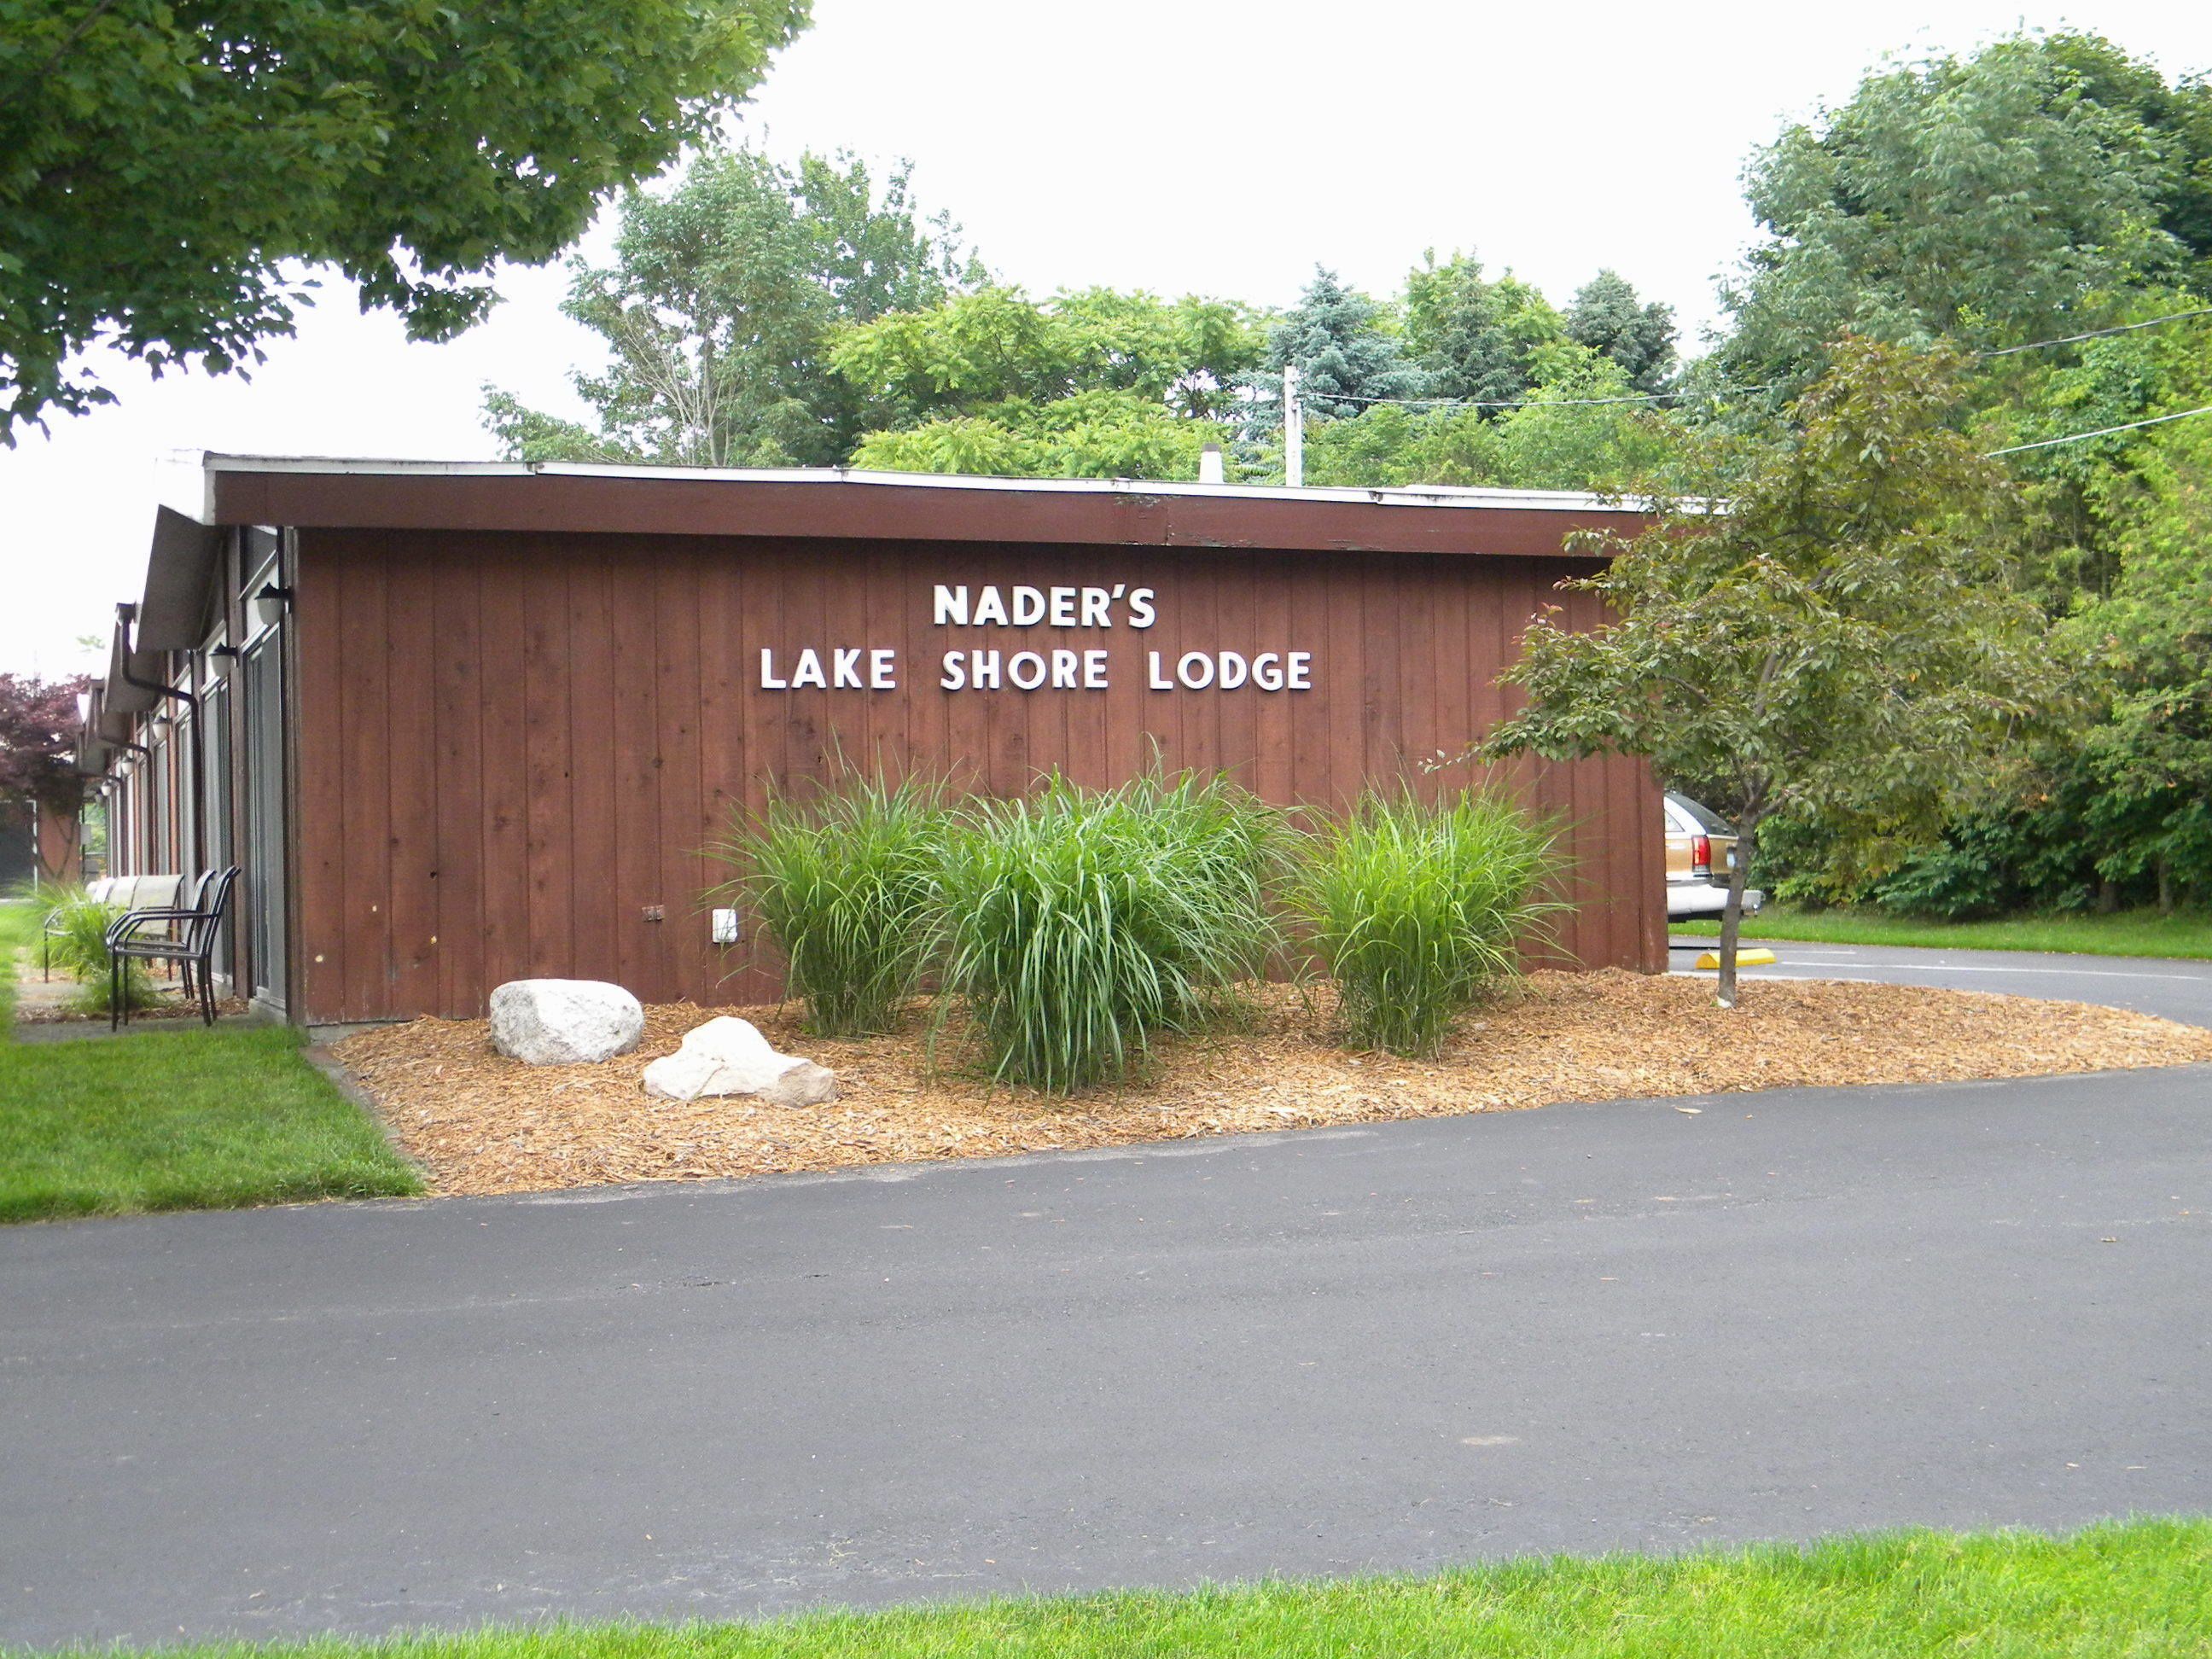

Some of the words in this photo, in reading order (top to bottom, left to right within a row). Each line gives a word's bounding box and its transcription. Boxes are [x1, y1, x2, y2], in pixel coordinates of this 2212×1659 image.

[933, 584, 1156, 628] NADER'S
[760, 648, 897, 690] LAKE
[940, 649, 1109, 690] SHORE
[1149, 650, 1313, 691] LODGE
